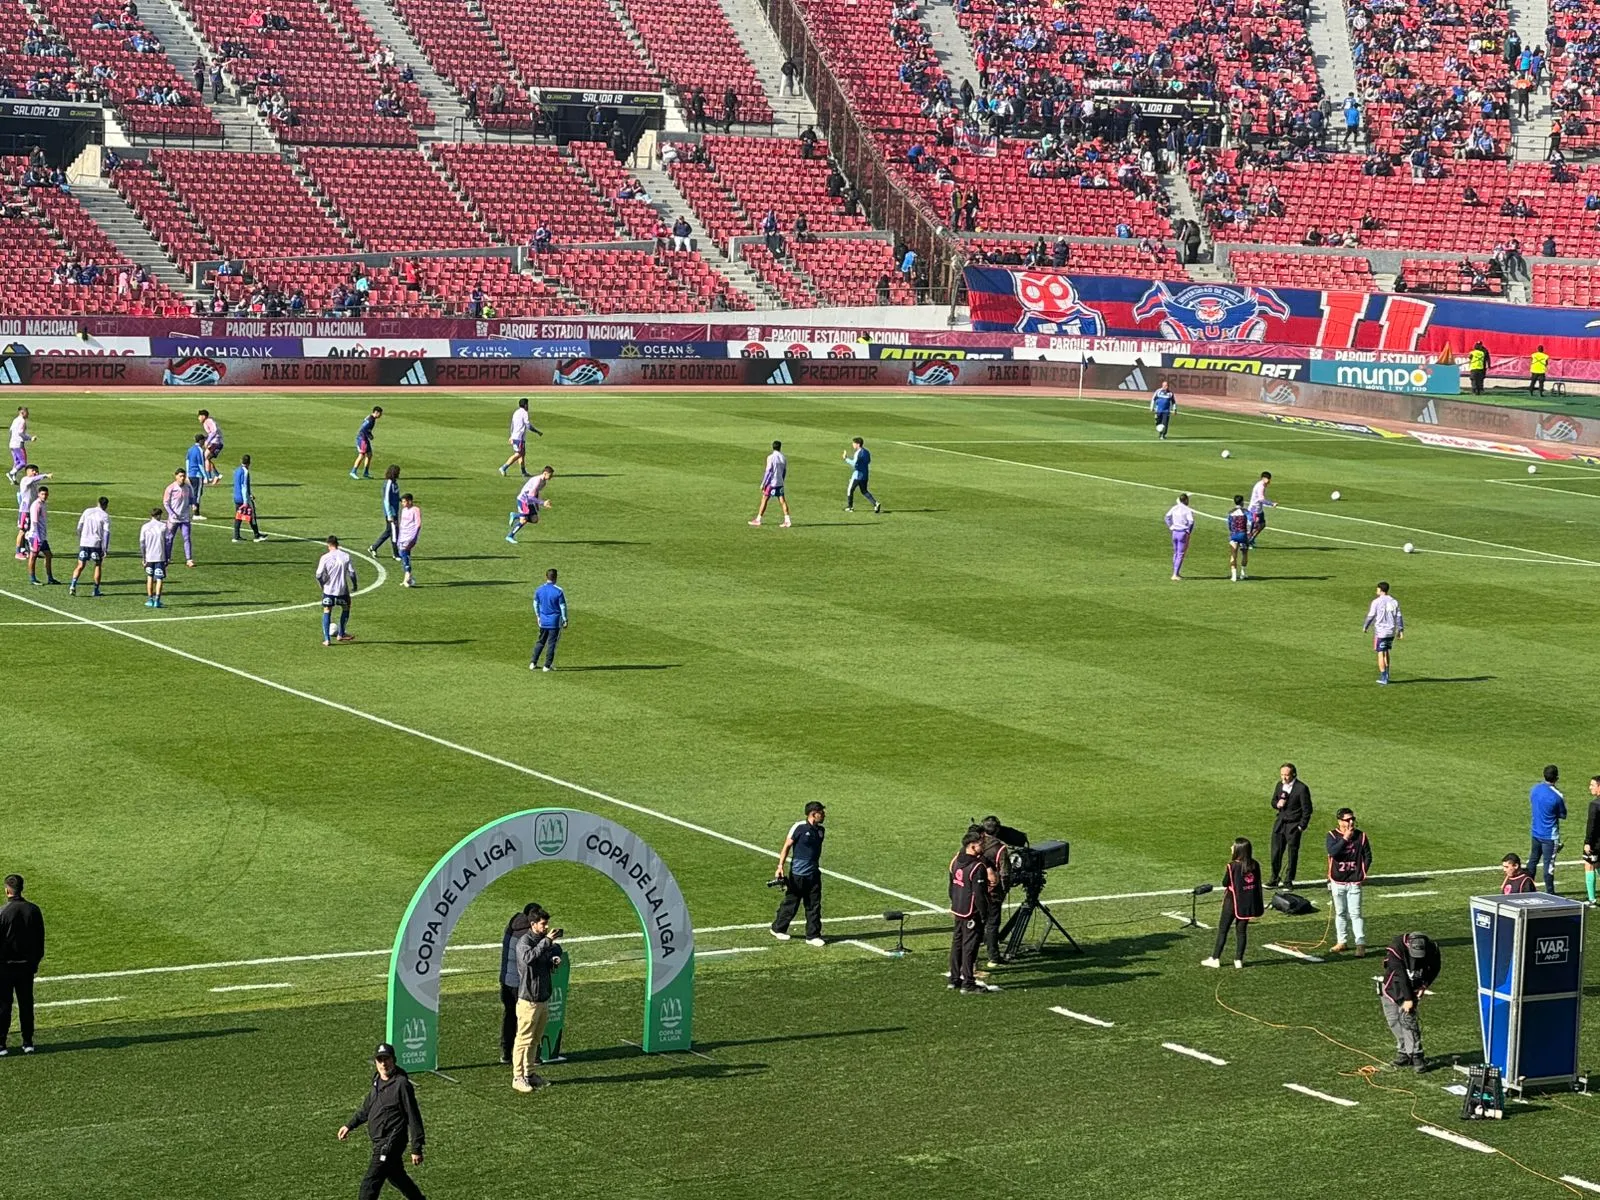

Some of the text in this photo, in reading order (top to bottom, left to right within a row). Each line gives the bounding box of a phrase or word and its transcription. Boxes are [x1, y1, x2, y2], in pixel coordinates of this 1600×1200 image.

[581, 93, 612, 104] SALIDA
[614, 94, 623, 104] 19
[12, 105, 46, 117] SALIDA
[47, 107, 60, 117] 20
[1163, 104, 1174, 114] 18
[226, 321, 366, 338] PARQUE ESTADIO NACIONAL
[500, 323, 636, 340] PARQUE ESTADIO NACIONAL
[771, 328, 912, 346] PARQUE ESTADIO ACIONAL
[643, 345, 684, 354] OCEAN
[1050, 336, 1191, 355] PARQUE ESTADIO NACIONAL
[30, 363, 126, 379] PREDATOR
[261, 363, 368, 380] TAKE CONTROL
[436, 364, 521, 380] PREDATOR
[641, 364, 738, 380] TAKE CONTROL
[800, 365, 878, 380] PREDATOR
[988, 366, 1020, 380] TAKE
[1338, 861, 1357, 872] 275
[586, 834, 676, 959] COPA DE LA LIGA
[415, 838, 517, 975] COPA DE LA LIGA
[1540, 940, 1565, 954] VAR
